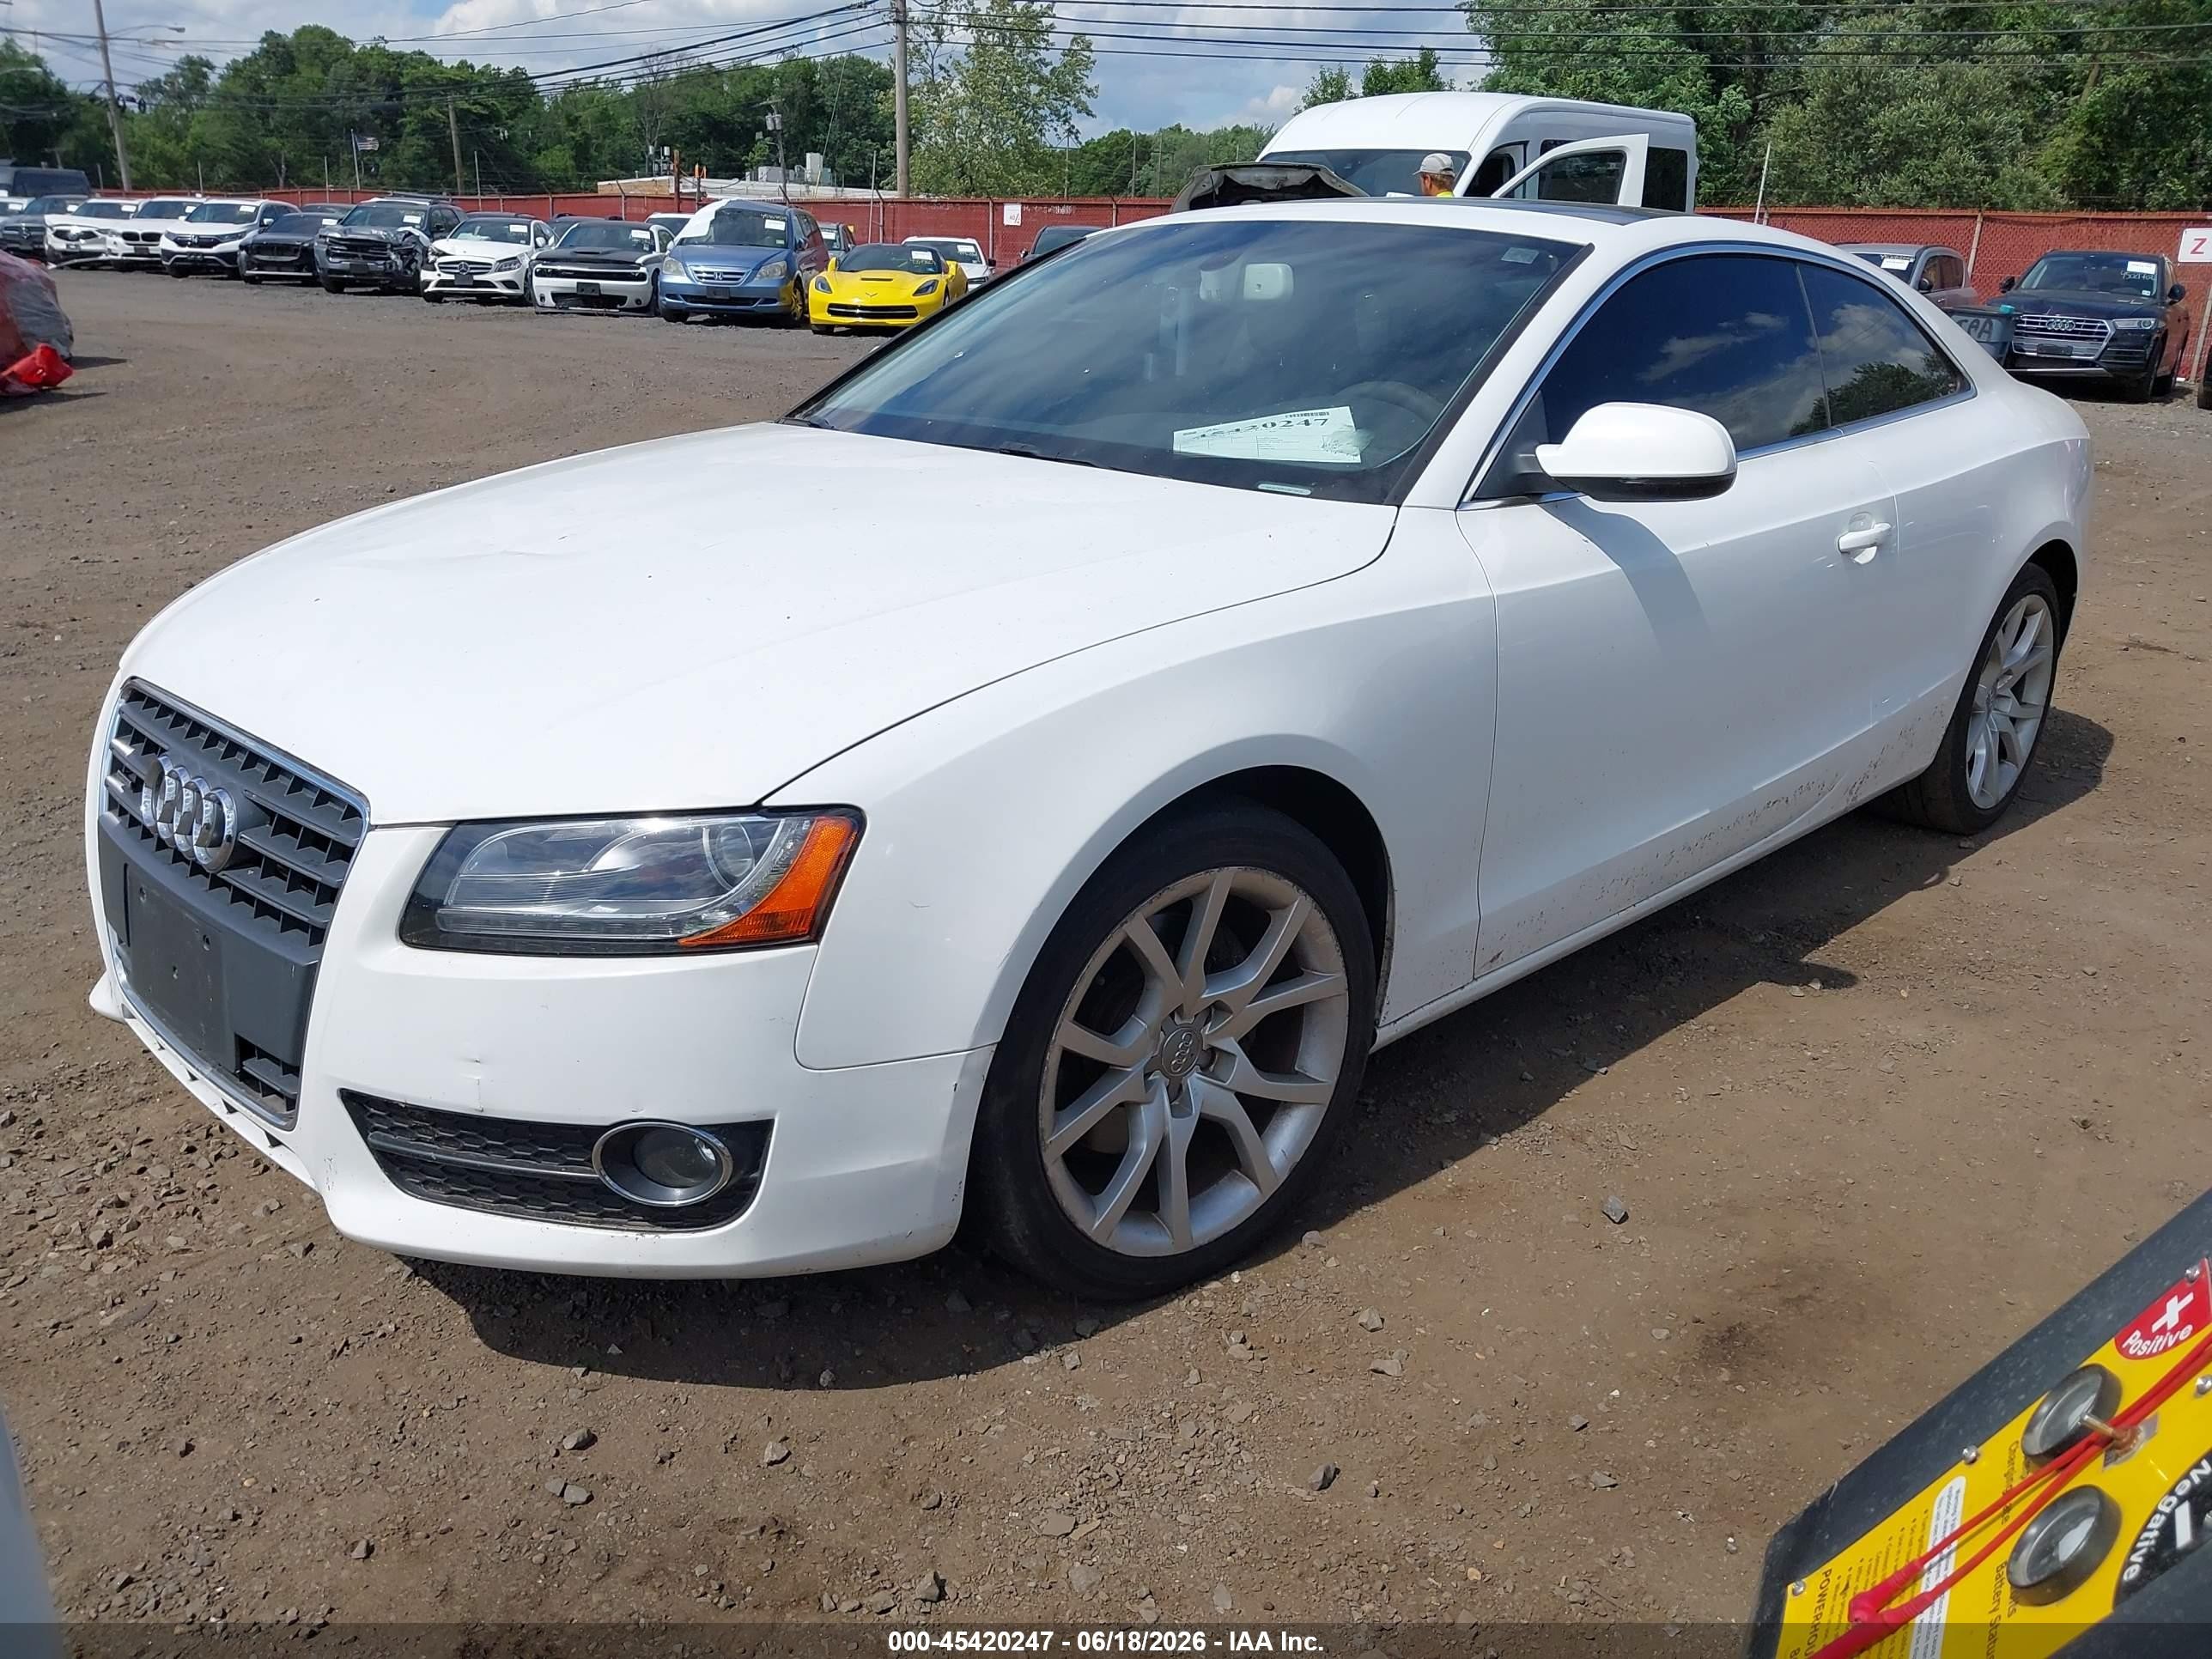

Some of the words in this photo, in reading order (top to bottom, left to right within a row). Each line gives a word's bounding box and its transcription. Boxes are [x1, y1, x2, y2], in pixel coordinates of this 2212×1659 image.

[2190, 237, 2208, 255] Z
[2122, 1324, 2193, 1356] Positive
[2123, 1459, 2212, 1582] Negative
[1803, 1568, 1832, 1657] POWERHOU
[1989, 1559, 2007, 1614] Battery
